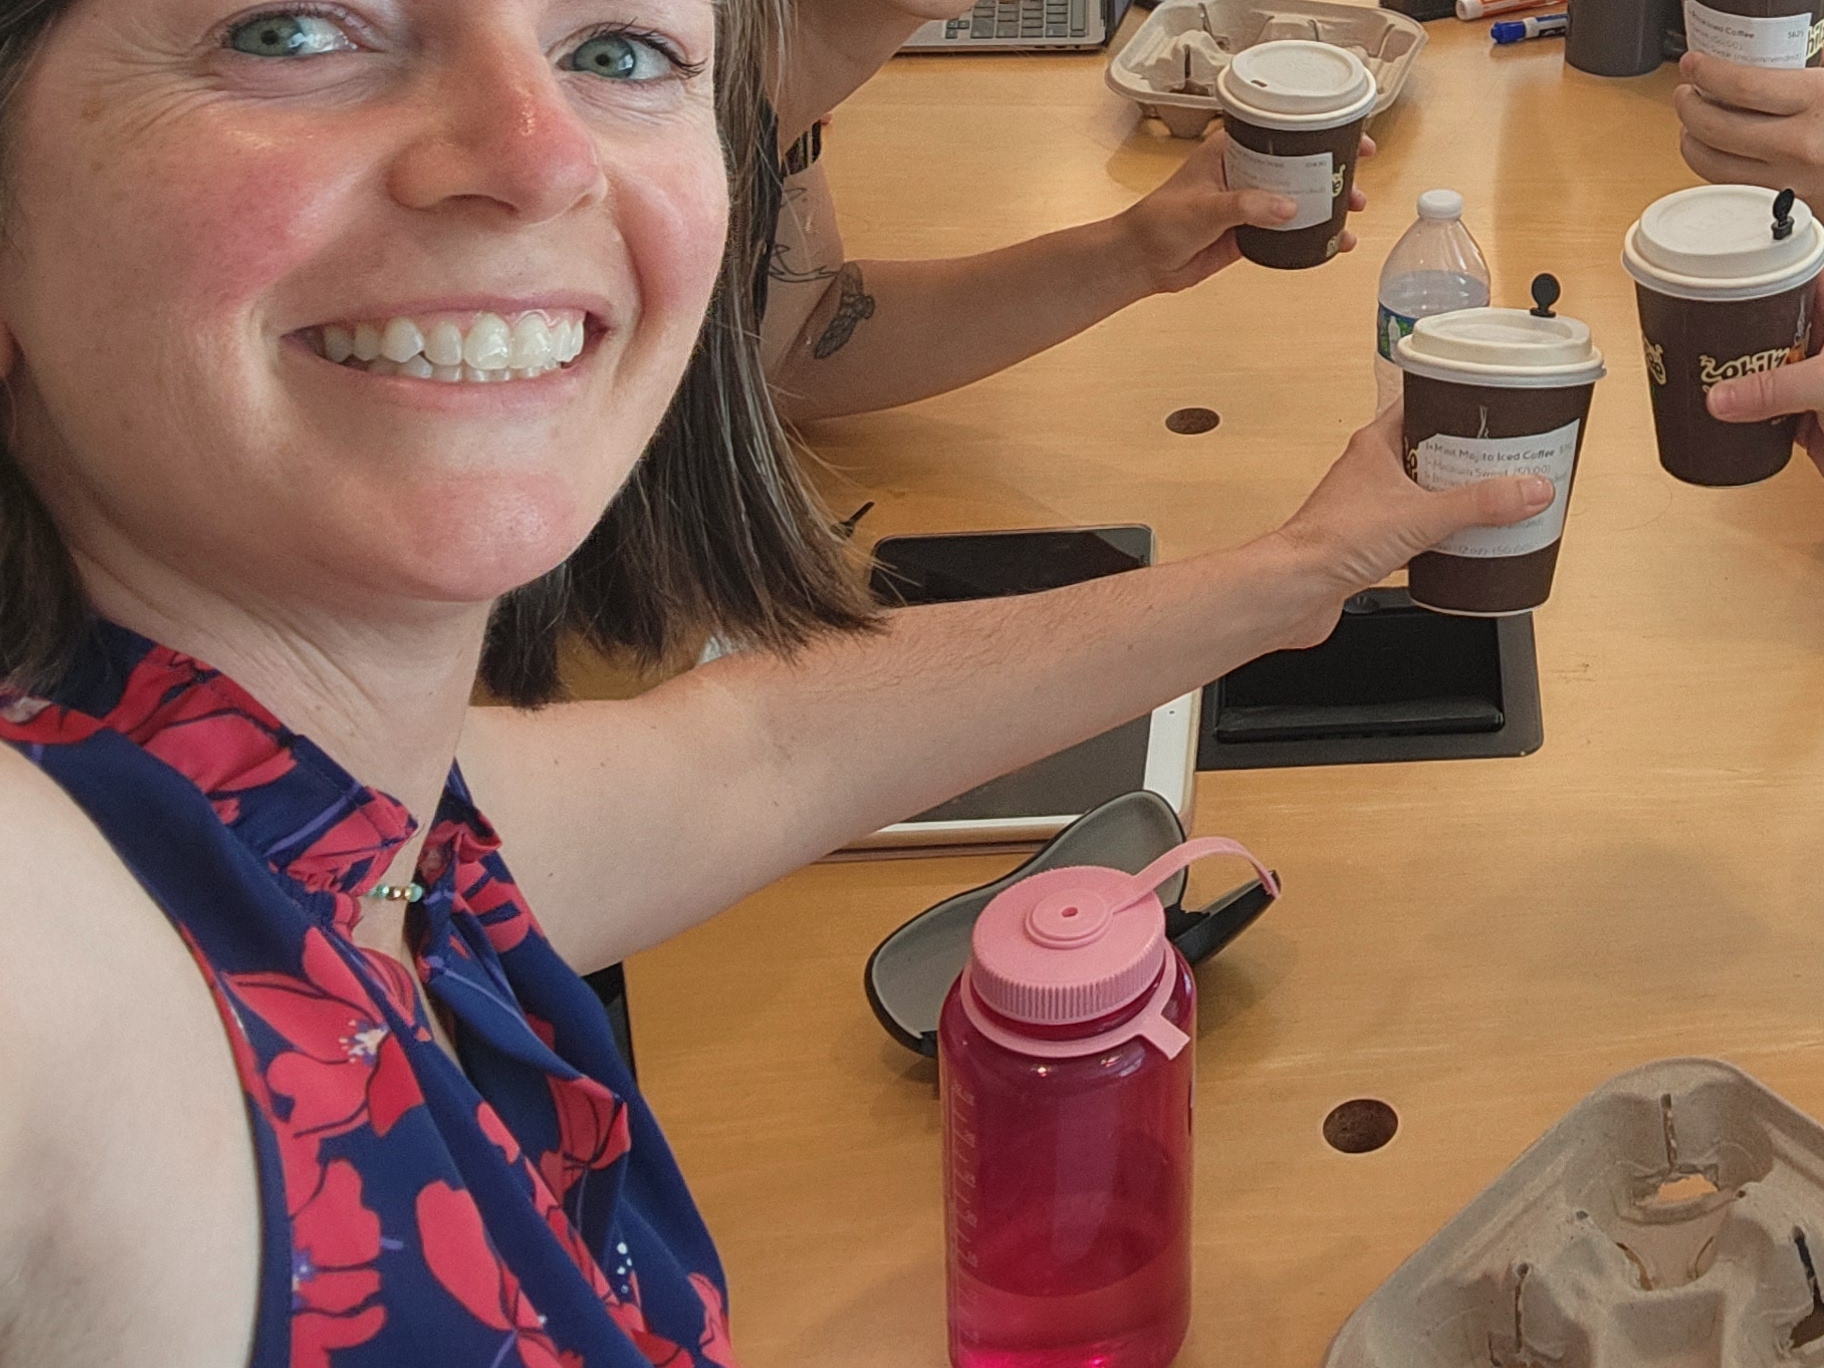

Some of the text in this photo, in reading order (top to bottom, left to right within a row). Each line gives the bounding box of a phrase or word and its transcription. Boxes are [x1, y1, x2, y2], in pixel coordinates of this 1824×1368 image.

[1725, 26, 1755, 39] Coffee
[1496, 450, 1521, 462] Iced
[1522, 447, 1556, 460] Coffee
